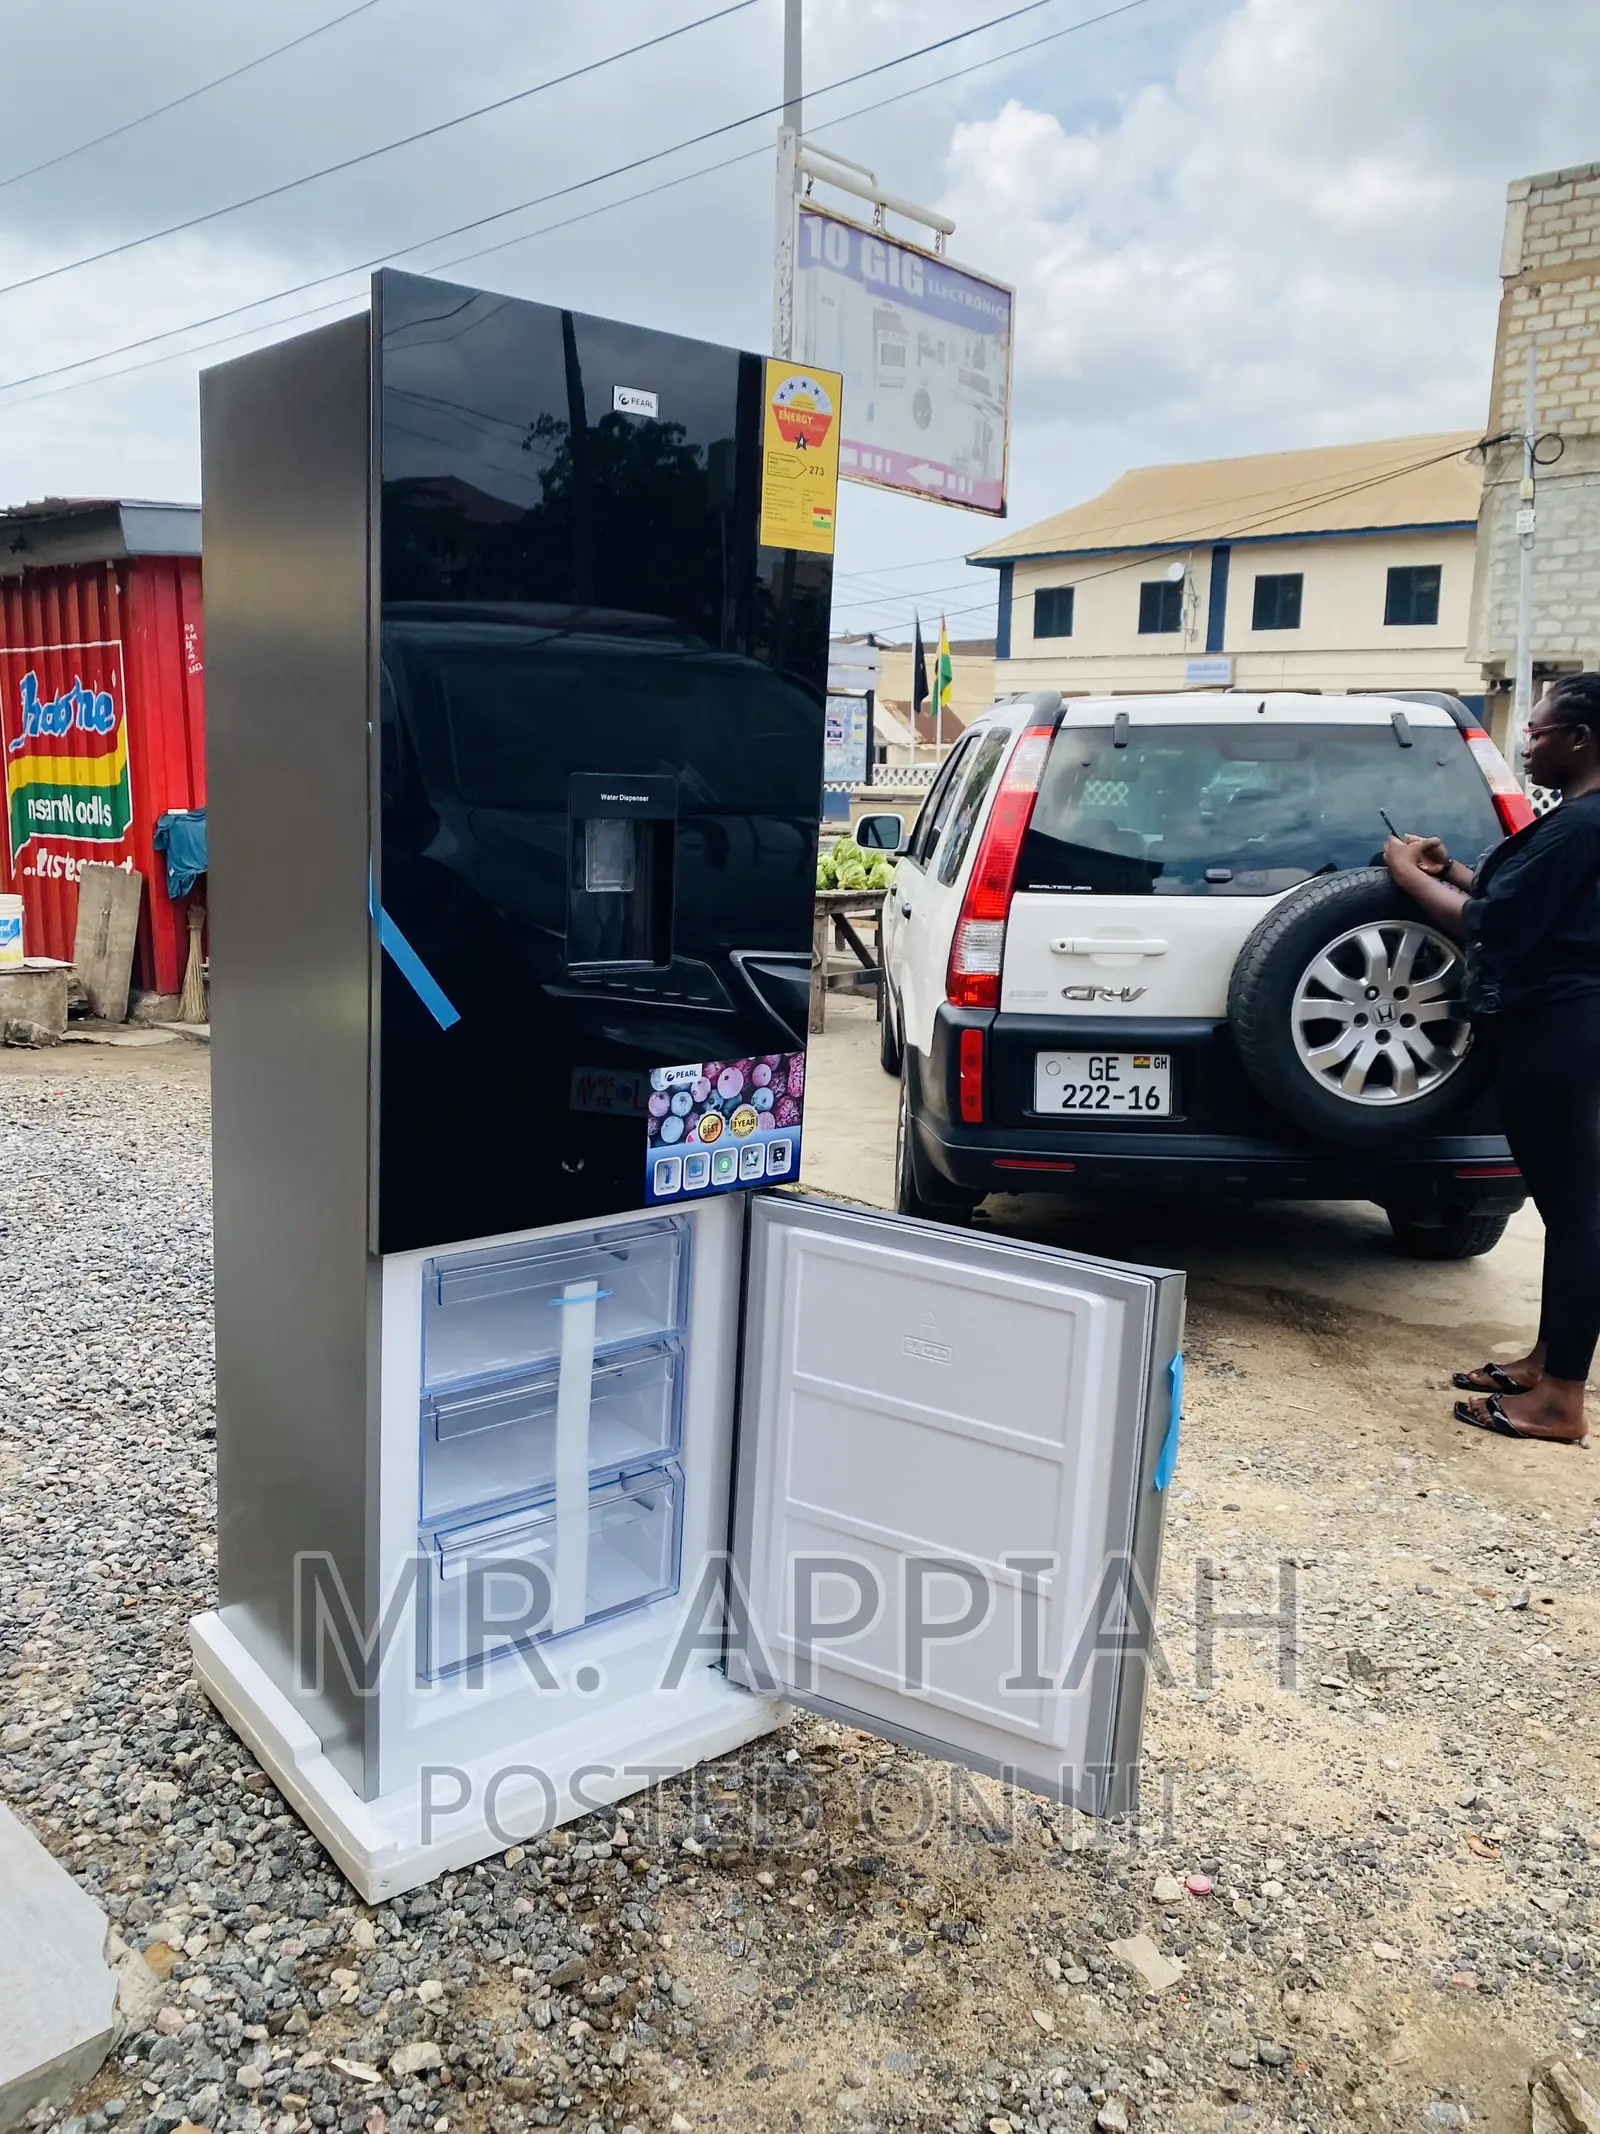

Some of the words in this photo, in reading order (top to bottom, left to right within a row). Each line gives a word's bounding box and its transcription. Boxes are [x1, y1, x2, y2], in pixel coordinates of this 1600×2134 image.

[804, 217, 849, 270] 10
[861, 236, 923, 298] GIG
[631, 397, 654, 409] PEARL
[778, 408, 813, 425] ENERGY
[809, 465, 824, 477] 273
[600, 793, 618, 801] Water
[619, 794, 649, 802] Dispenser
[1153, 1056, 1168, 1069] GH
[675, 1069, 698, 1079] PEARL
[1088, 1056, 1120, 1082] GE
[1061, 1084, 1161, 1110] 222-16
[702, 1122, 719, 1134] BEST
[738, 1118, 755, 1127] YEAR
